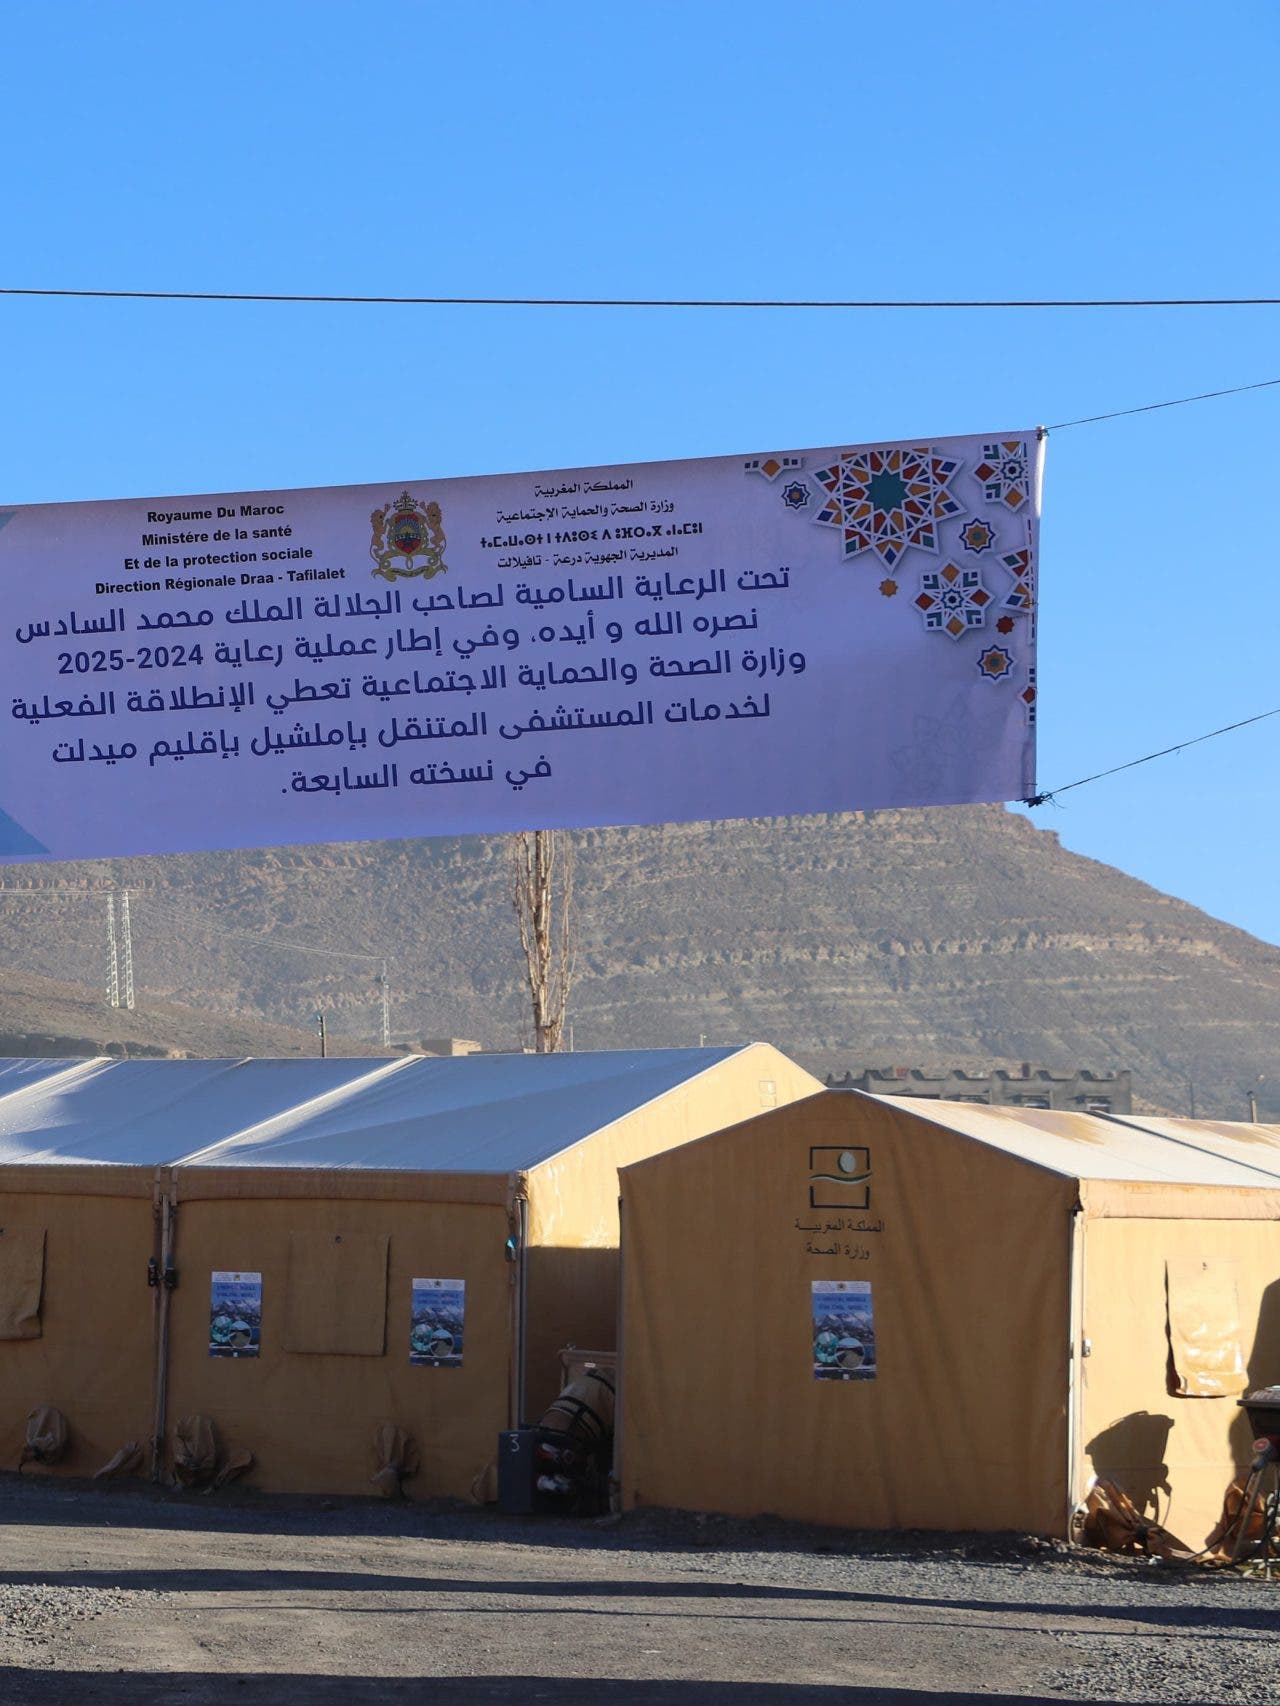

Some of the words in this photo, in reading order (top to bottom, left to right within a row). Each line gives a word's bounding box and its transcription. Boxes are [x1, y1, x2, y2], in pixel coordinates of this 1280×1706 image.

[534, 483, 580, 497] المغربية
[584, 480, 633, 494] المملكة
[147, 510, 212, 524] Royaume
[217, 507, 235, 518] Du
[240, 505, 284, 516] Maroc
[562, 504, 608, 519] والحماية
[611, 501, 647, 515] الصحة
[650, 500, 674, 514] وزارة
[213, 530, 231, 541] de
[235, 529, 248, 540] la
[252, 525, 292, 539] santé
[124, 558, 139, 570] Et
[144, 557, 161, 569] de
[165, 556, 178, 568] la
[183, 551, 257, 569] protection
[261, 547, 313, 561] sociale
[497, 554, 542, 569] تافيلالت
[553, 553, 582, 566] درعة
[584, 549, 627, 564] الجهوية
[630, 546, 678, 561] المديرية
[95, 580, 161, 595] Direction
[165, 574, 236, 592] Régionale
[240, 572, 274, 585] Draa
[287, 568, 345, 582] Tafilalet
[516, 576, 623, 610] السامية
[635, 569, 726, 601] الرعاية
[737, 567, 790, 590] تحت
[225, 597, 302, 624] الملك
[314, 590, 401, 620] الجلالة
[412, 584, 504, 616] لصاحب
[16, 608, 125, 643] السادس
[137, 610, 213, 630] محمد
[606, 622, 623, 643] و
[635, 611, 682, 635] الله
[693, 608, 757, 639] نصره
[215, 639, 283, 668] رعاية
[295, 634, 377, 663] عملية
[385, 627, 443, 660] إطار
[453, 624, 519, 659] وفي
[518, 657, 637, 690] والحماية
[650, 650, 731, 677] الصحة
[742, 647, 806, 678] وزارة
[127, 682, 254, 712] الإنطلاقة
[266, 678, 351, 715] تعطي
[362, 665, 506, 701] الاجتماعية
[12, 691, 115, 725] الفعلية
[499, 701, 653, 740] المستشفى
[665, 693, 770, 722] لخدمات
[251, 721, 367, 756] بإملشيل
[378, 712, 487, 747] المتنقل
[53, 738, 137, 765] ميدلت
[149, 729, 240, 766] بإقليم
[410, 760, 493, 784] نسخته
[505, 755, 552, 790] في
